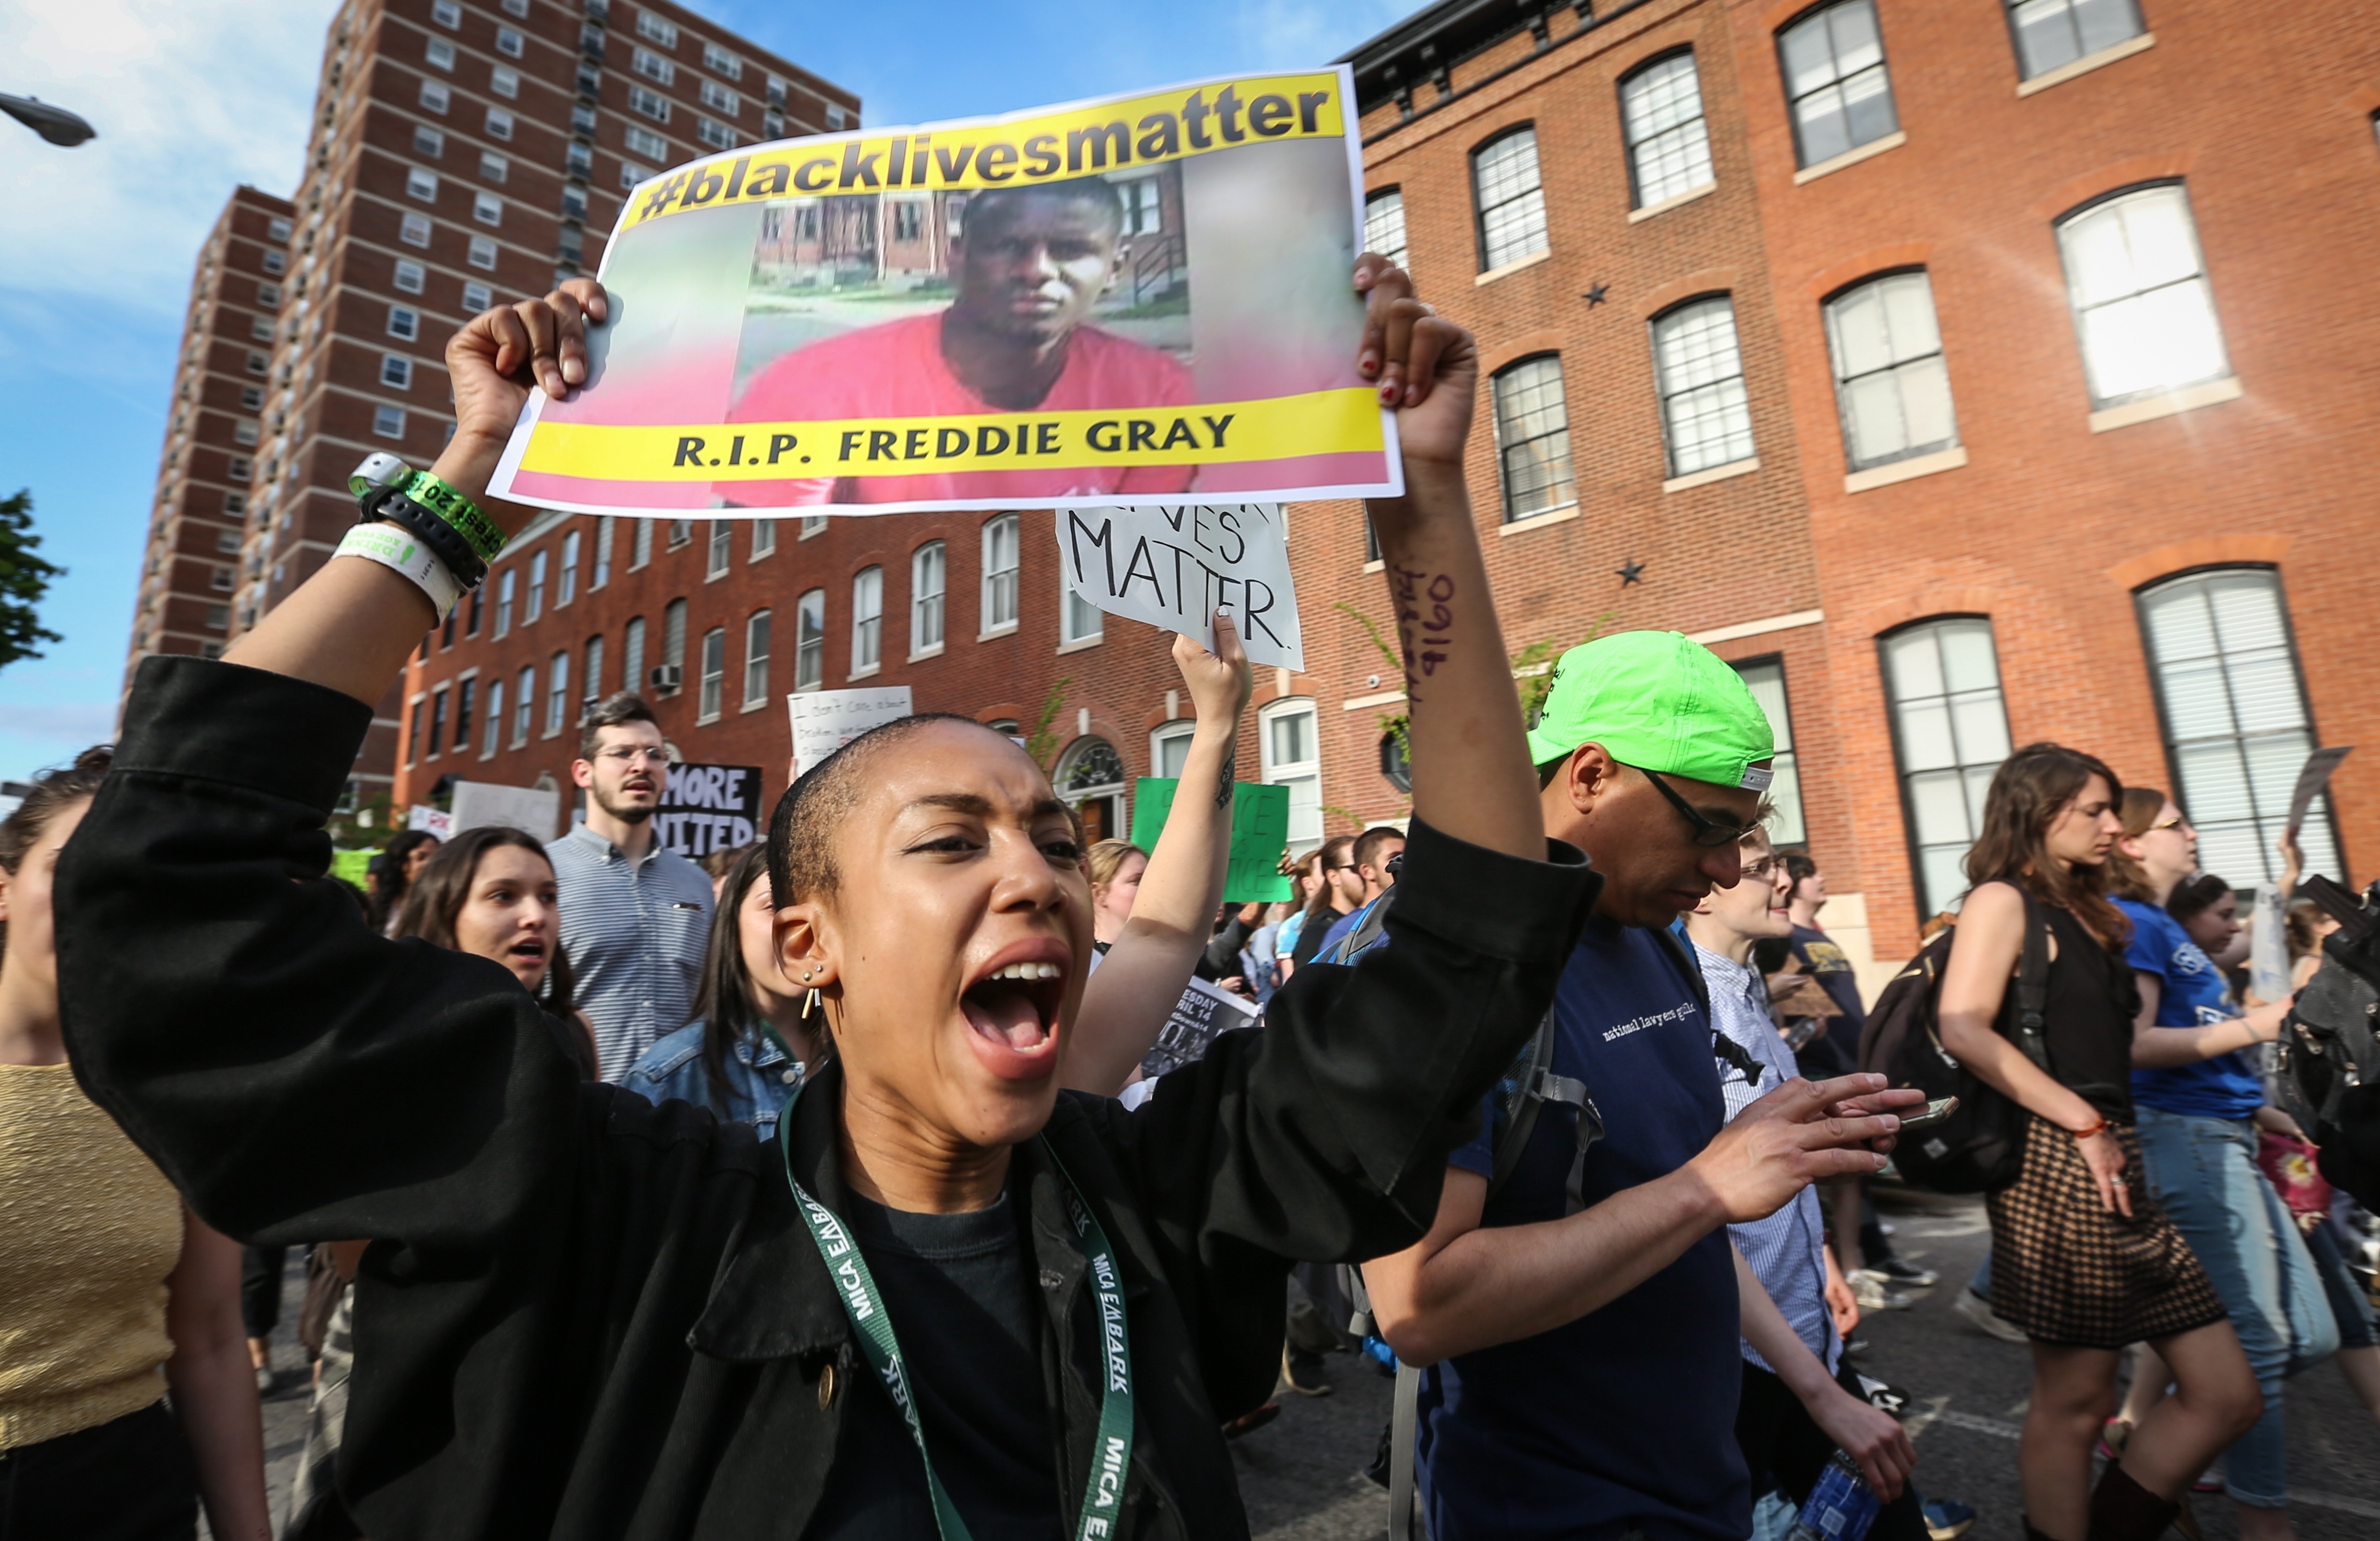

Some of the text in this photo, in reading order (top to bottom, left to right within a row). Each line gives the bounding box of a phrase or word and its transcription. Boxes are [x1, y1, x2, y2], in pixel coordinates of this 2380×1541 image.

[644, 84, 1329, 216] #blacklivesmatter
[673, 413, 1236, 467] R.I.P. FREDDIE GRAY
[1114, 505, 1245, 564] VES
[659, 764, 746, 810] MORE
[651, 812, 754, 856] NITED
[1175, 999, 1212, 1021] RIL 14
[1181, 989, 1219, 1011] ESDAY
[1603, 1019, 1640, 1042] national
[1639, 1010, 1677, 1026] lawyers
[838, 1258, 874, 1321] MICA
[1093, 1253, 1128, 1395] MICA EMBARK
[1094, 1436, 1126, 1508] MICA
